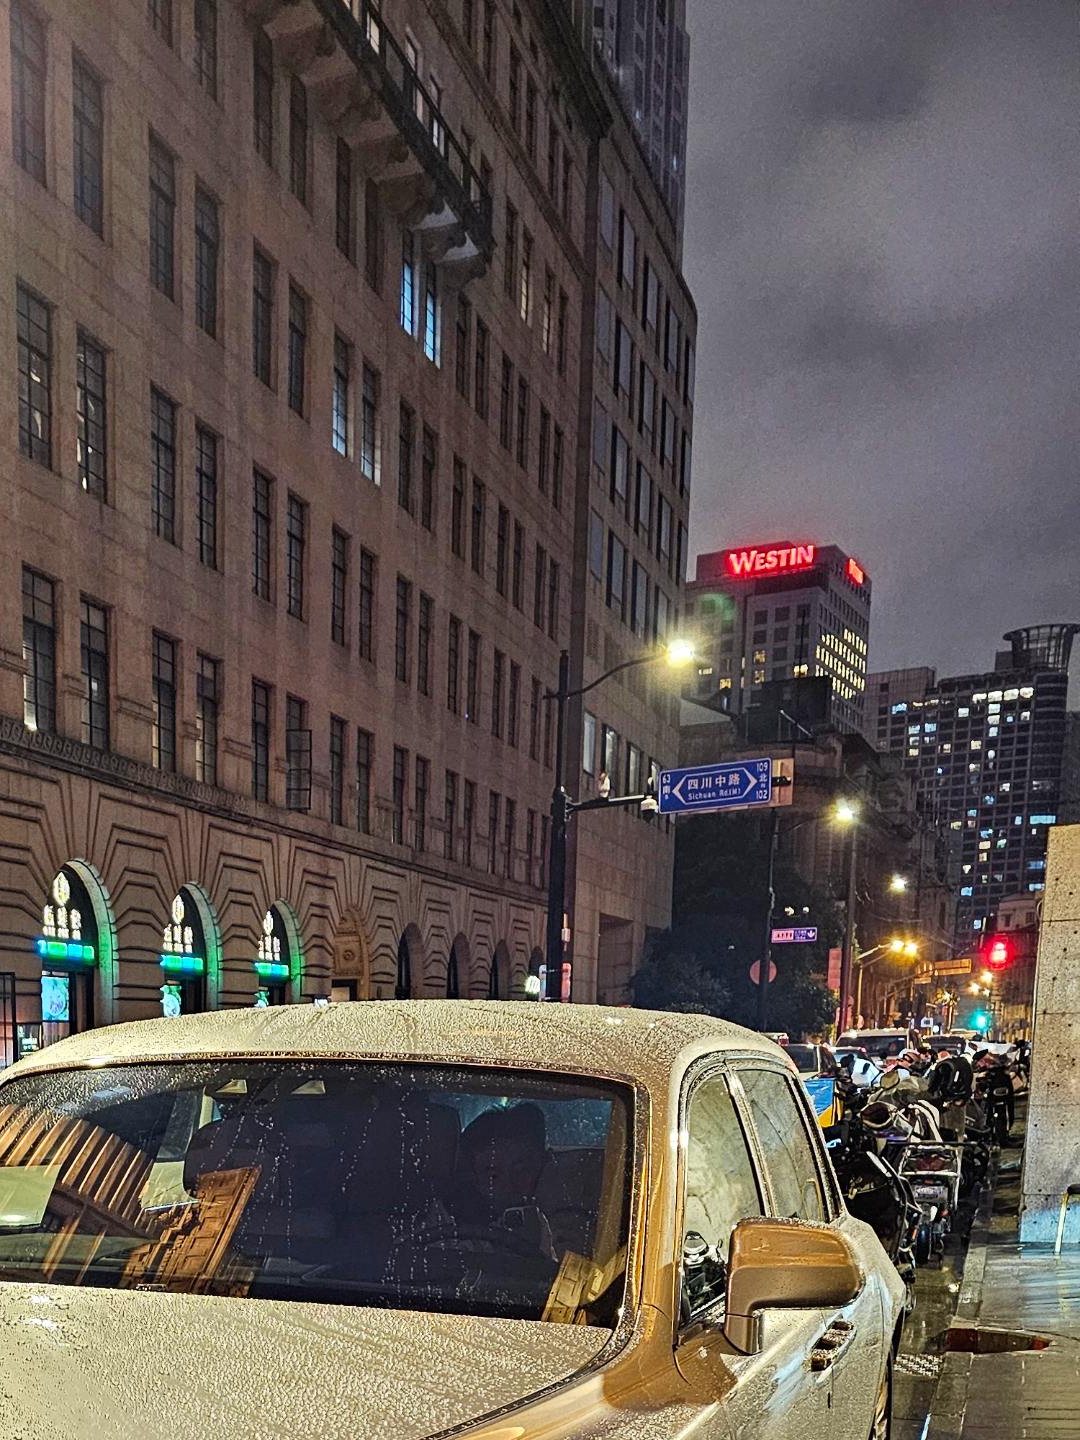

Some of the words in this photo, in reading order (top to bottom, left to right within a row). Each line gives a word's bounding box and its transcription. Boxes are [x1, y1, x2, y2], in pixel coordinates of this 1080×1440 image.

[729, 545, 814, 574] WESTIN
[757, 761, 768, 772] 109
[662, 774, 671, 784] 63
[687, 773, 740, 789] 四川中路
[688, 791, 716, 800] Sichuan
[756, 790, 768, 800] 102
